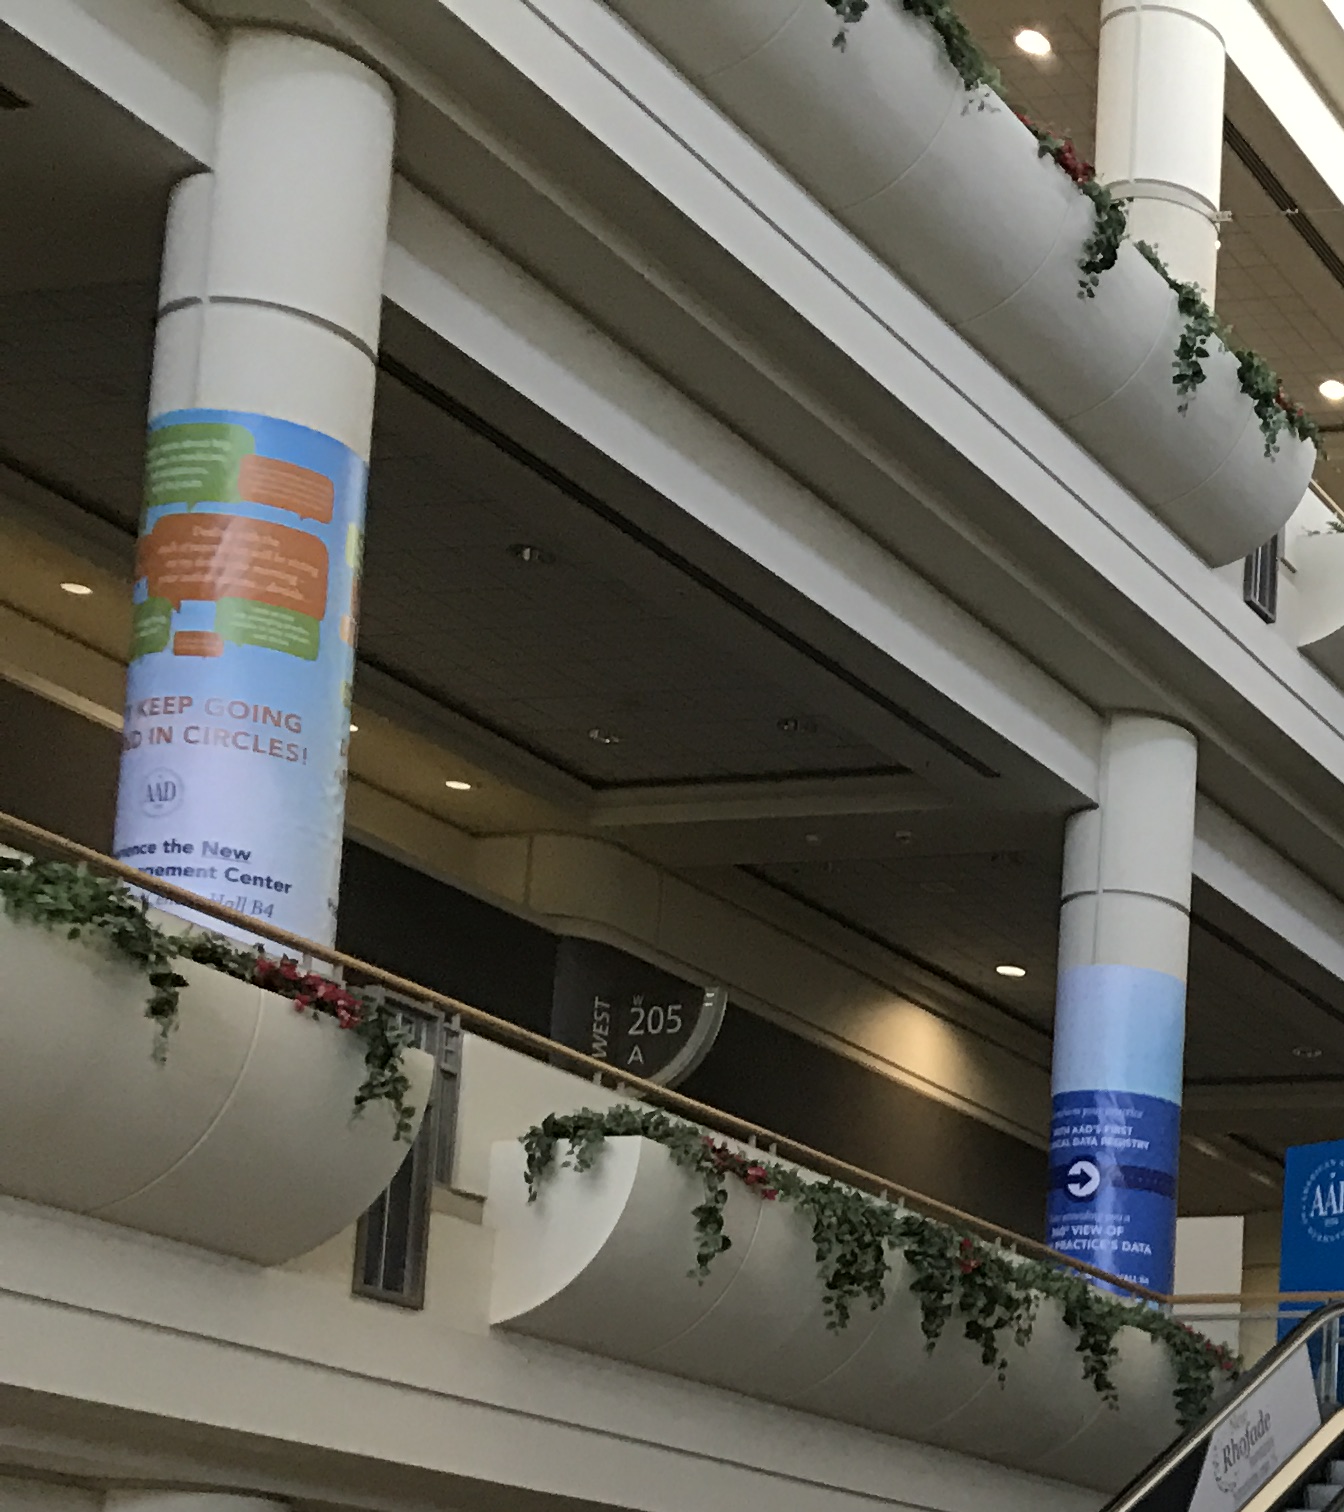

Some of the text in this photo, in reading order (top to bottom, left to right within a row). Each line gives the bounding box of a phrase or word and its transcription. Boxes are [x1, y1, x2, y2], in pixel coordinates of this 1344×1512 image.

[203, 697, 303, 734] GOING
[149, 726, 173, 745] IN
[183, 725, 308, 766] CIRCLES!
[162, 838, 195, 855] the
[201, 840, 252, 862] New
[223, 867, 293, 894] Center
[251, 900, 275, 919] B4
[591, 995, 611, 1058] WEST
[627, 1004, 683, 1036] 205
[626, 1045, 645, 1065] A
[1071, 1224, 1102, 1237] VIEW
[1121, 1241, 1152, 1255] DATA
[1222, 1409, 1271, 1474] Rhofade
